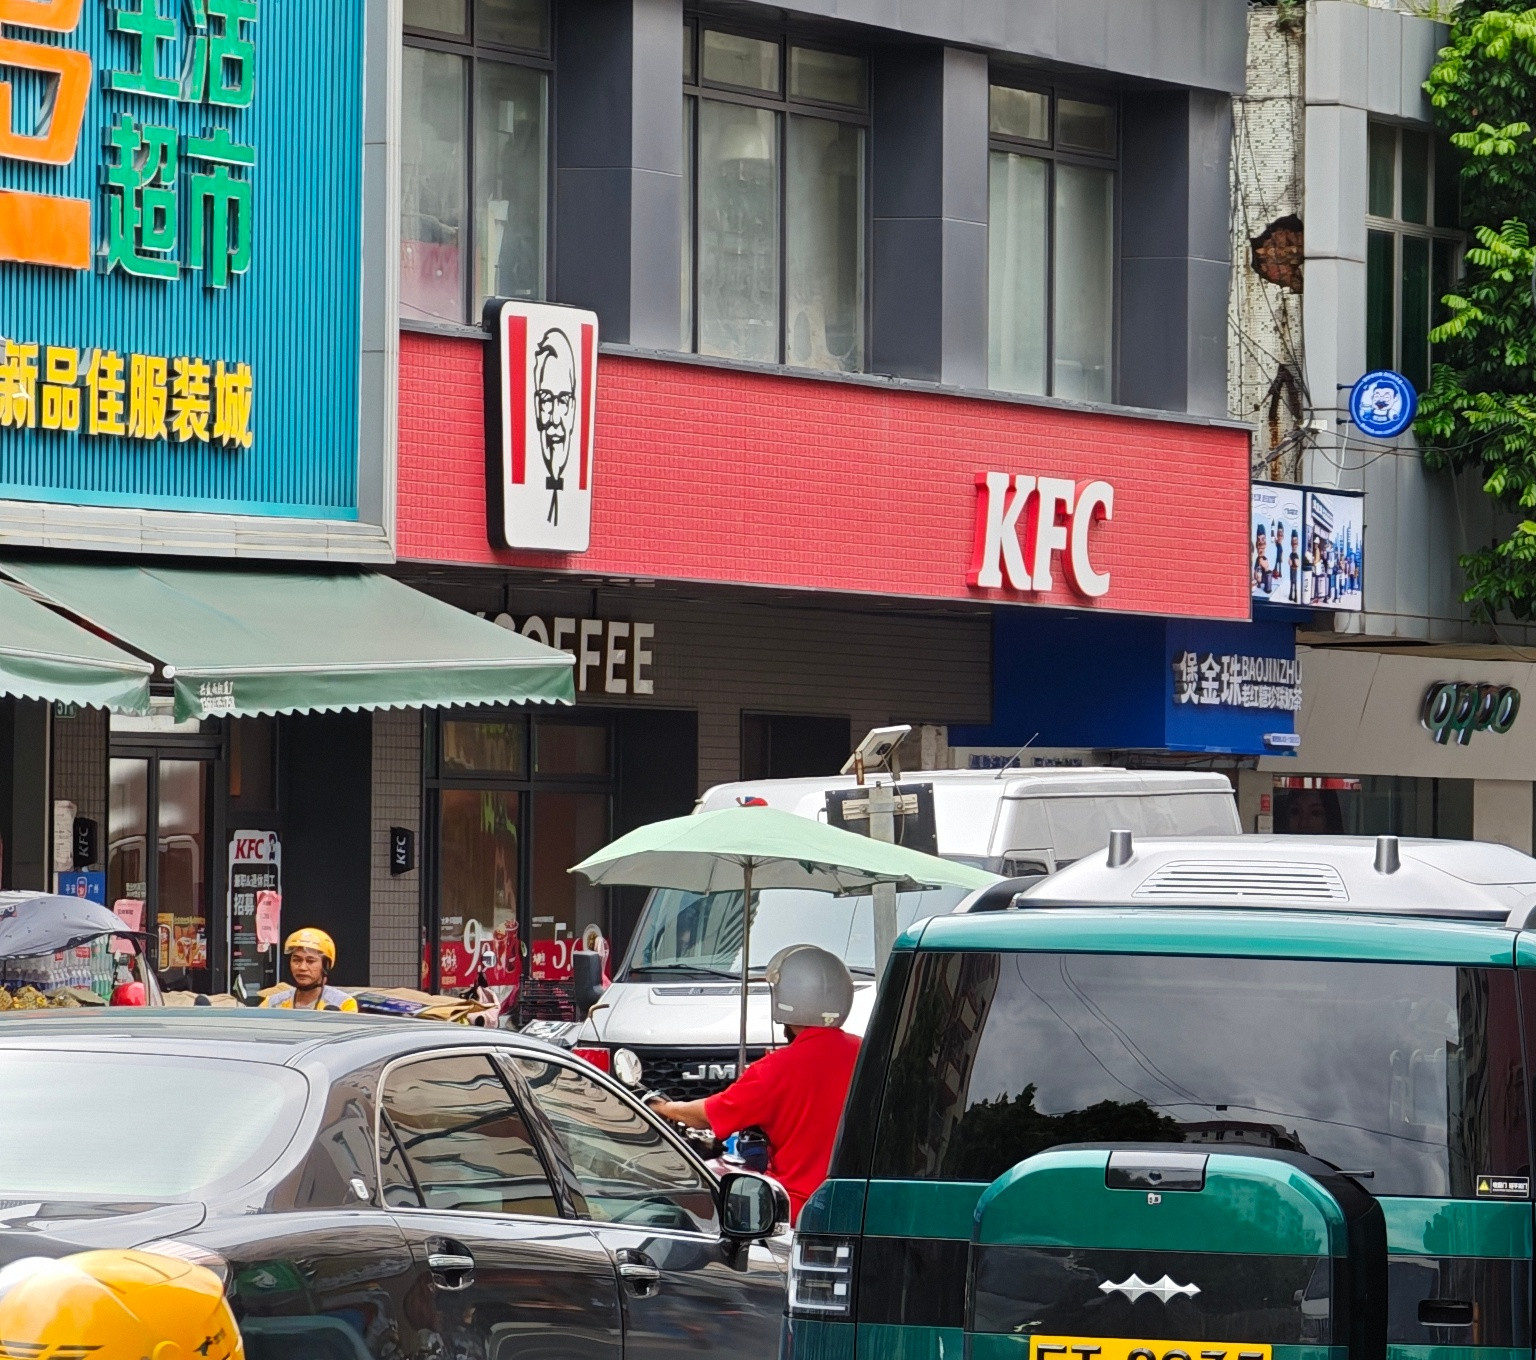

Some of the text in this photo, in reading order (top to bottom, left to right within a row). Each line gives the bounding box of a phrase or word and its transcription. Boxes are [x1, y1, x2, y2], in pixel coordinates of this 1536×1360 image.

[98, 112, 256, 289] 超市
[970, 471, 1115, 597] KFC
[1242, 656, 1304, 684] BAOJINZHU
[234, 838, 264, 860] KFC
[395, 836, 407, 866] KFC
